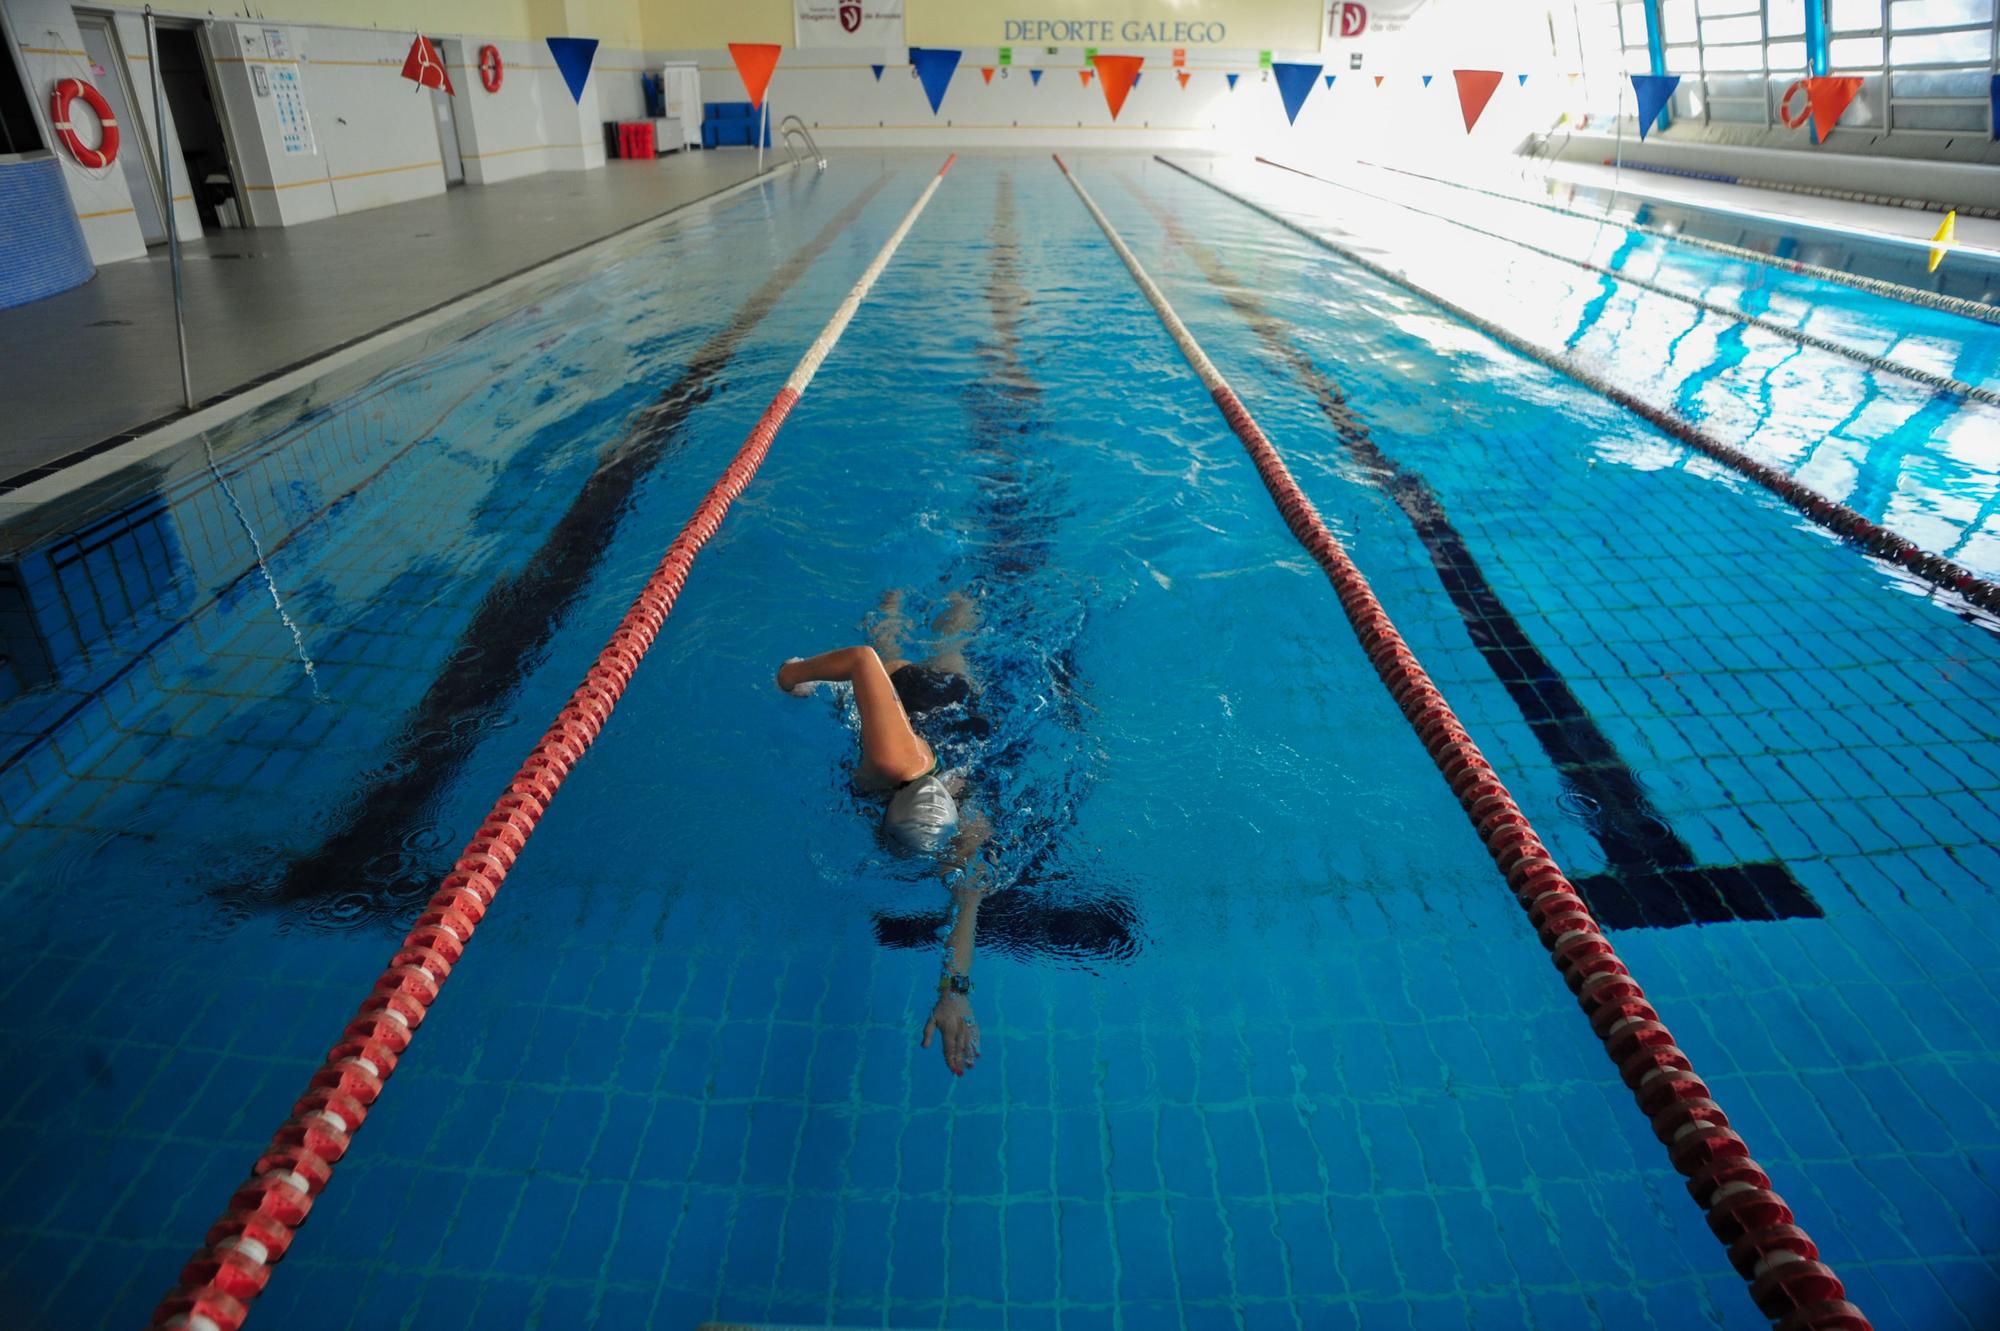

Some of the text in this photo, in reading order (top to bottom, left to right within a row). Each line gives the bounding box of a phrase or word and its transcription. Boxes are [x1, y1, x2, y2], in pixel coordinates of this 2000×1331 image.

[1004, 20, 1226, 42] DEPORTE GALEGO
[1001, 68, 1008, 79] 5
